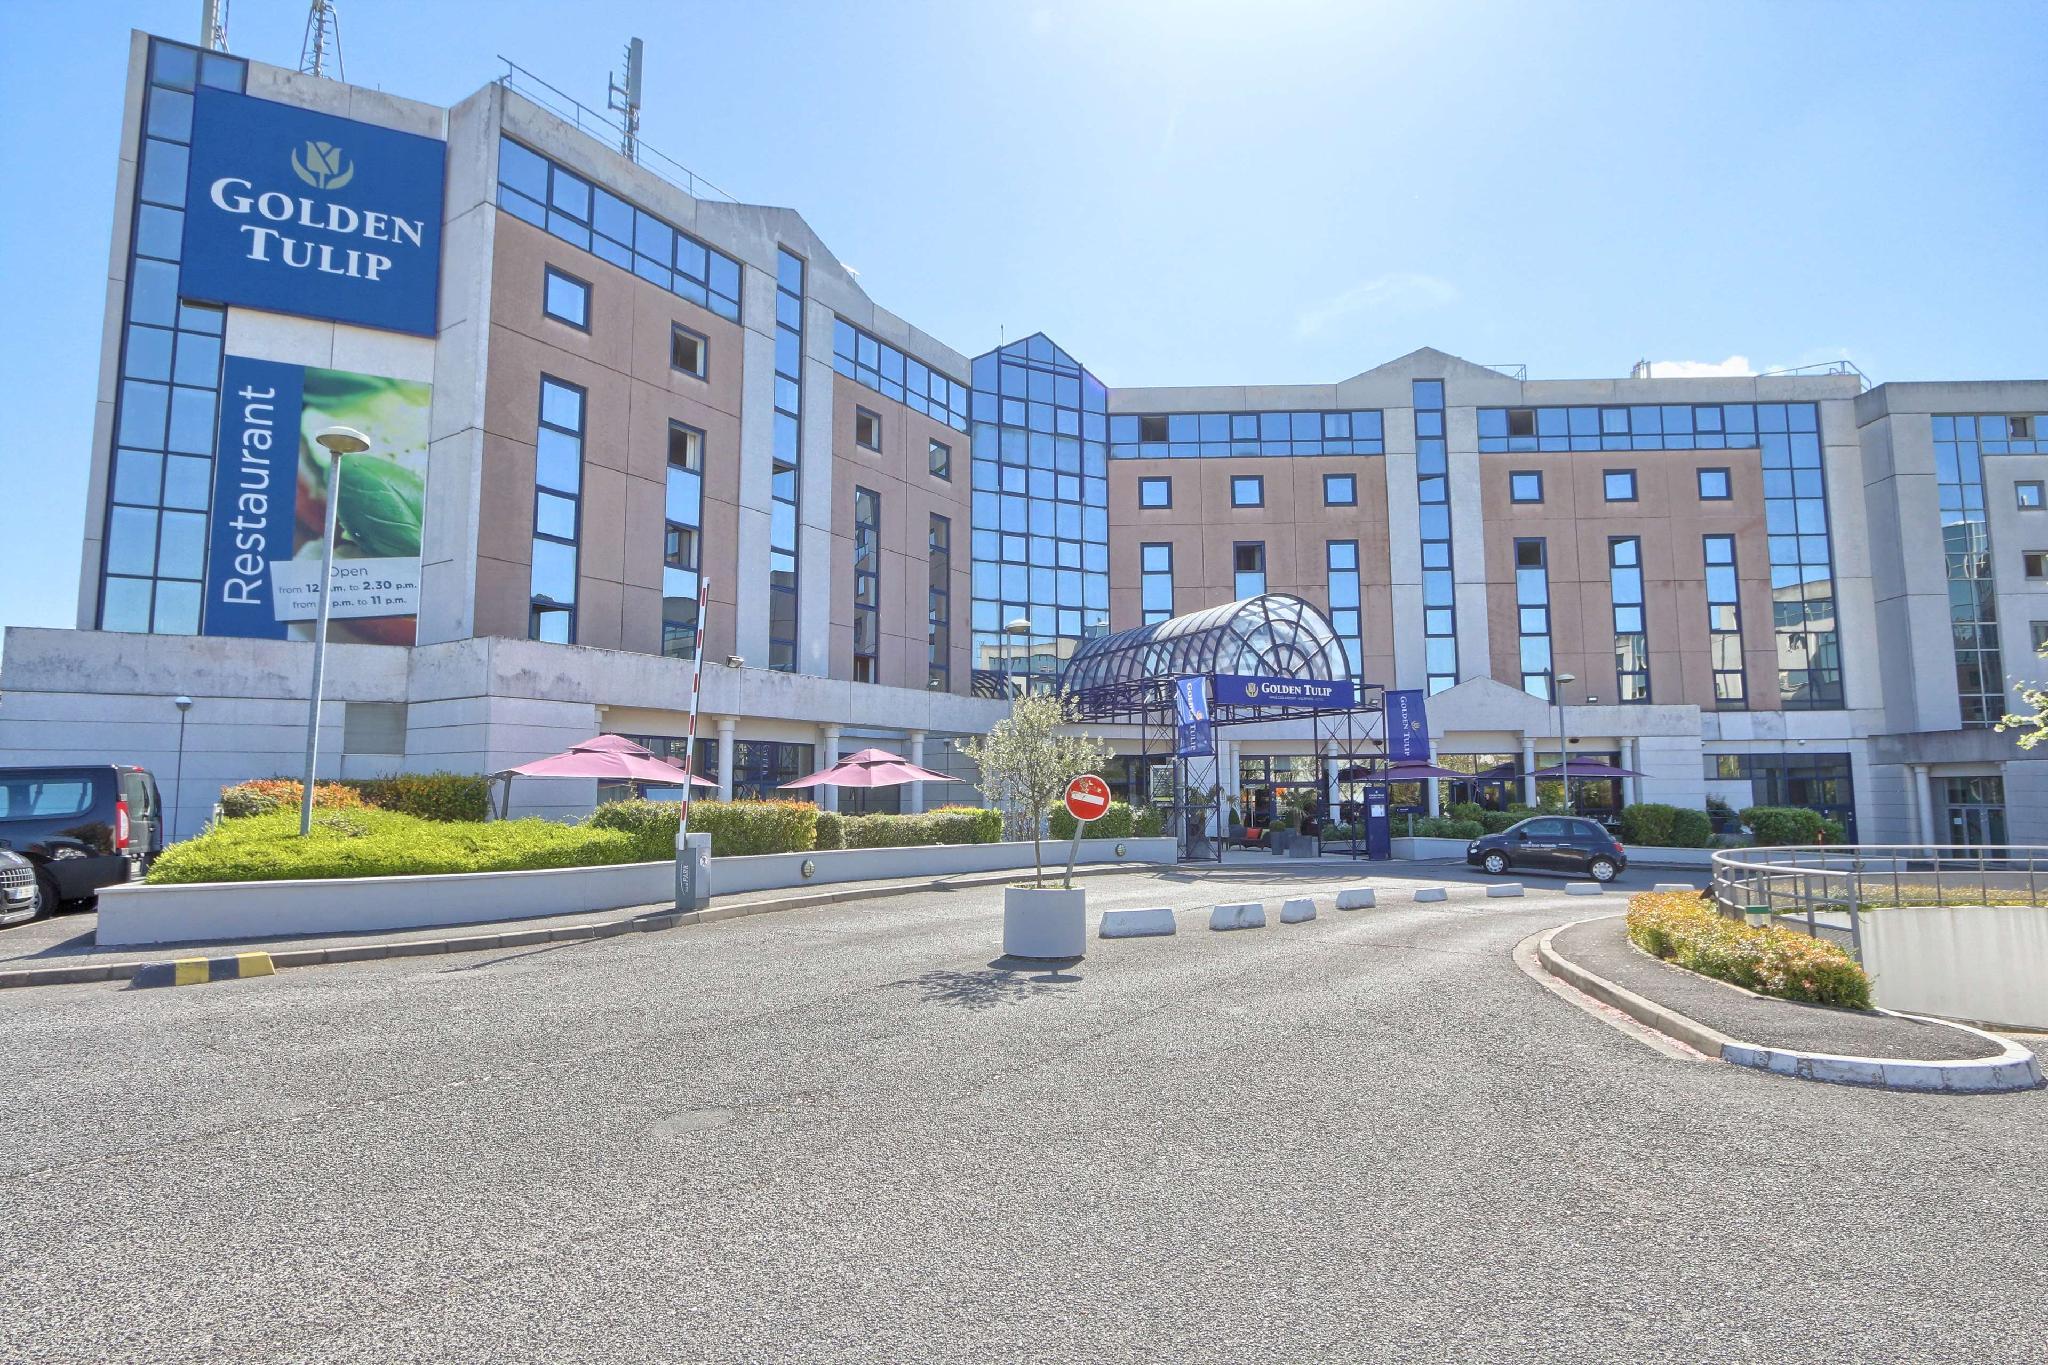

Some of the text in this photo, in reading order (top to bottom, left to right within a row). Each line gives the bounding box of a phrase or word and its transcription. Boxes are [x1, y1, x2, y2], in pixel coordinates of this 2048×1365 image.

[210, 177, 424, 248] GOLDEN
[240, 224, 392, 281] TULIP
[223, 385, 275, 605] Restaurant
[279, 584, 302, 594] from
[306, 583, 320, 593] 12
[362, 580, 392, 591] 2.30
[395, 582, 417, 590] p.m.
[292, 601, 317, 609] from
[370, 596, 381, 605] 11
[1261, 682, 1333, 697] GOLDEN TULIP
[1400, 695, 1411, 757] GOLDEN TULIP
